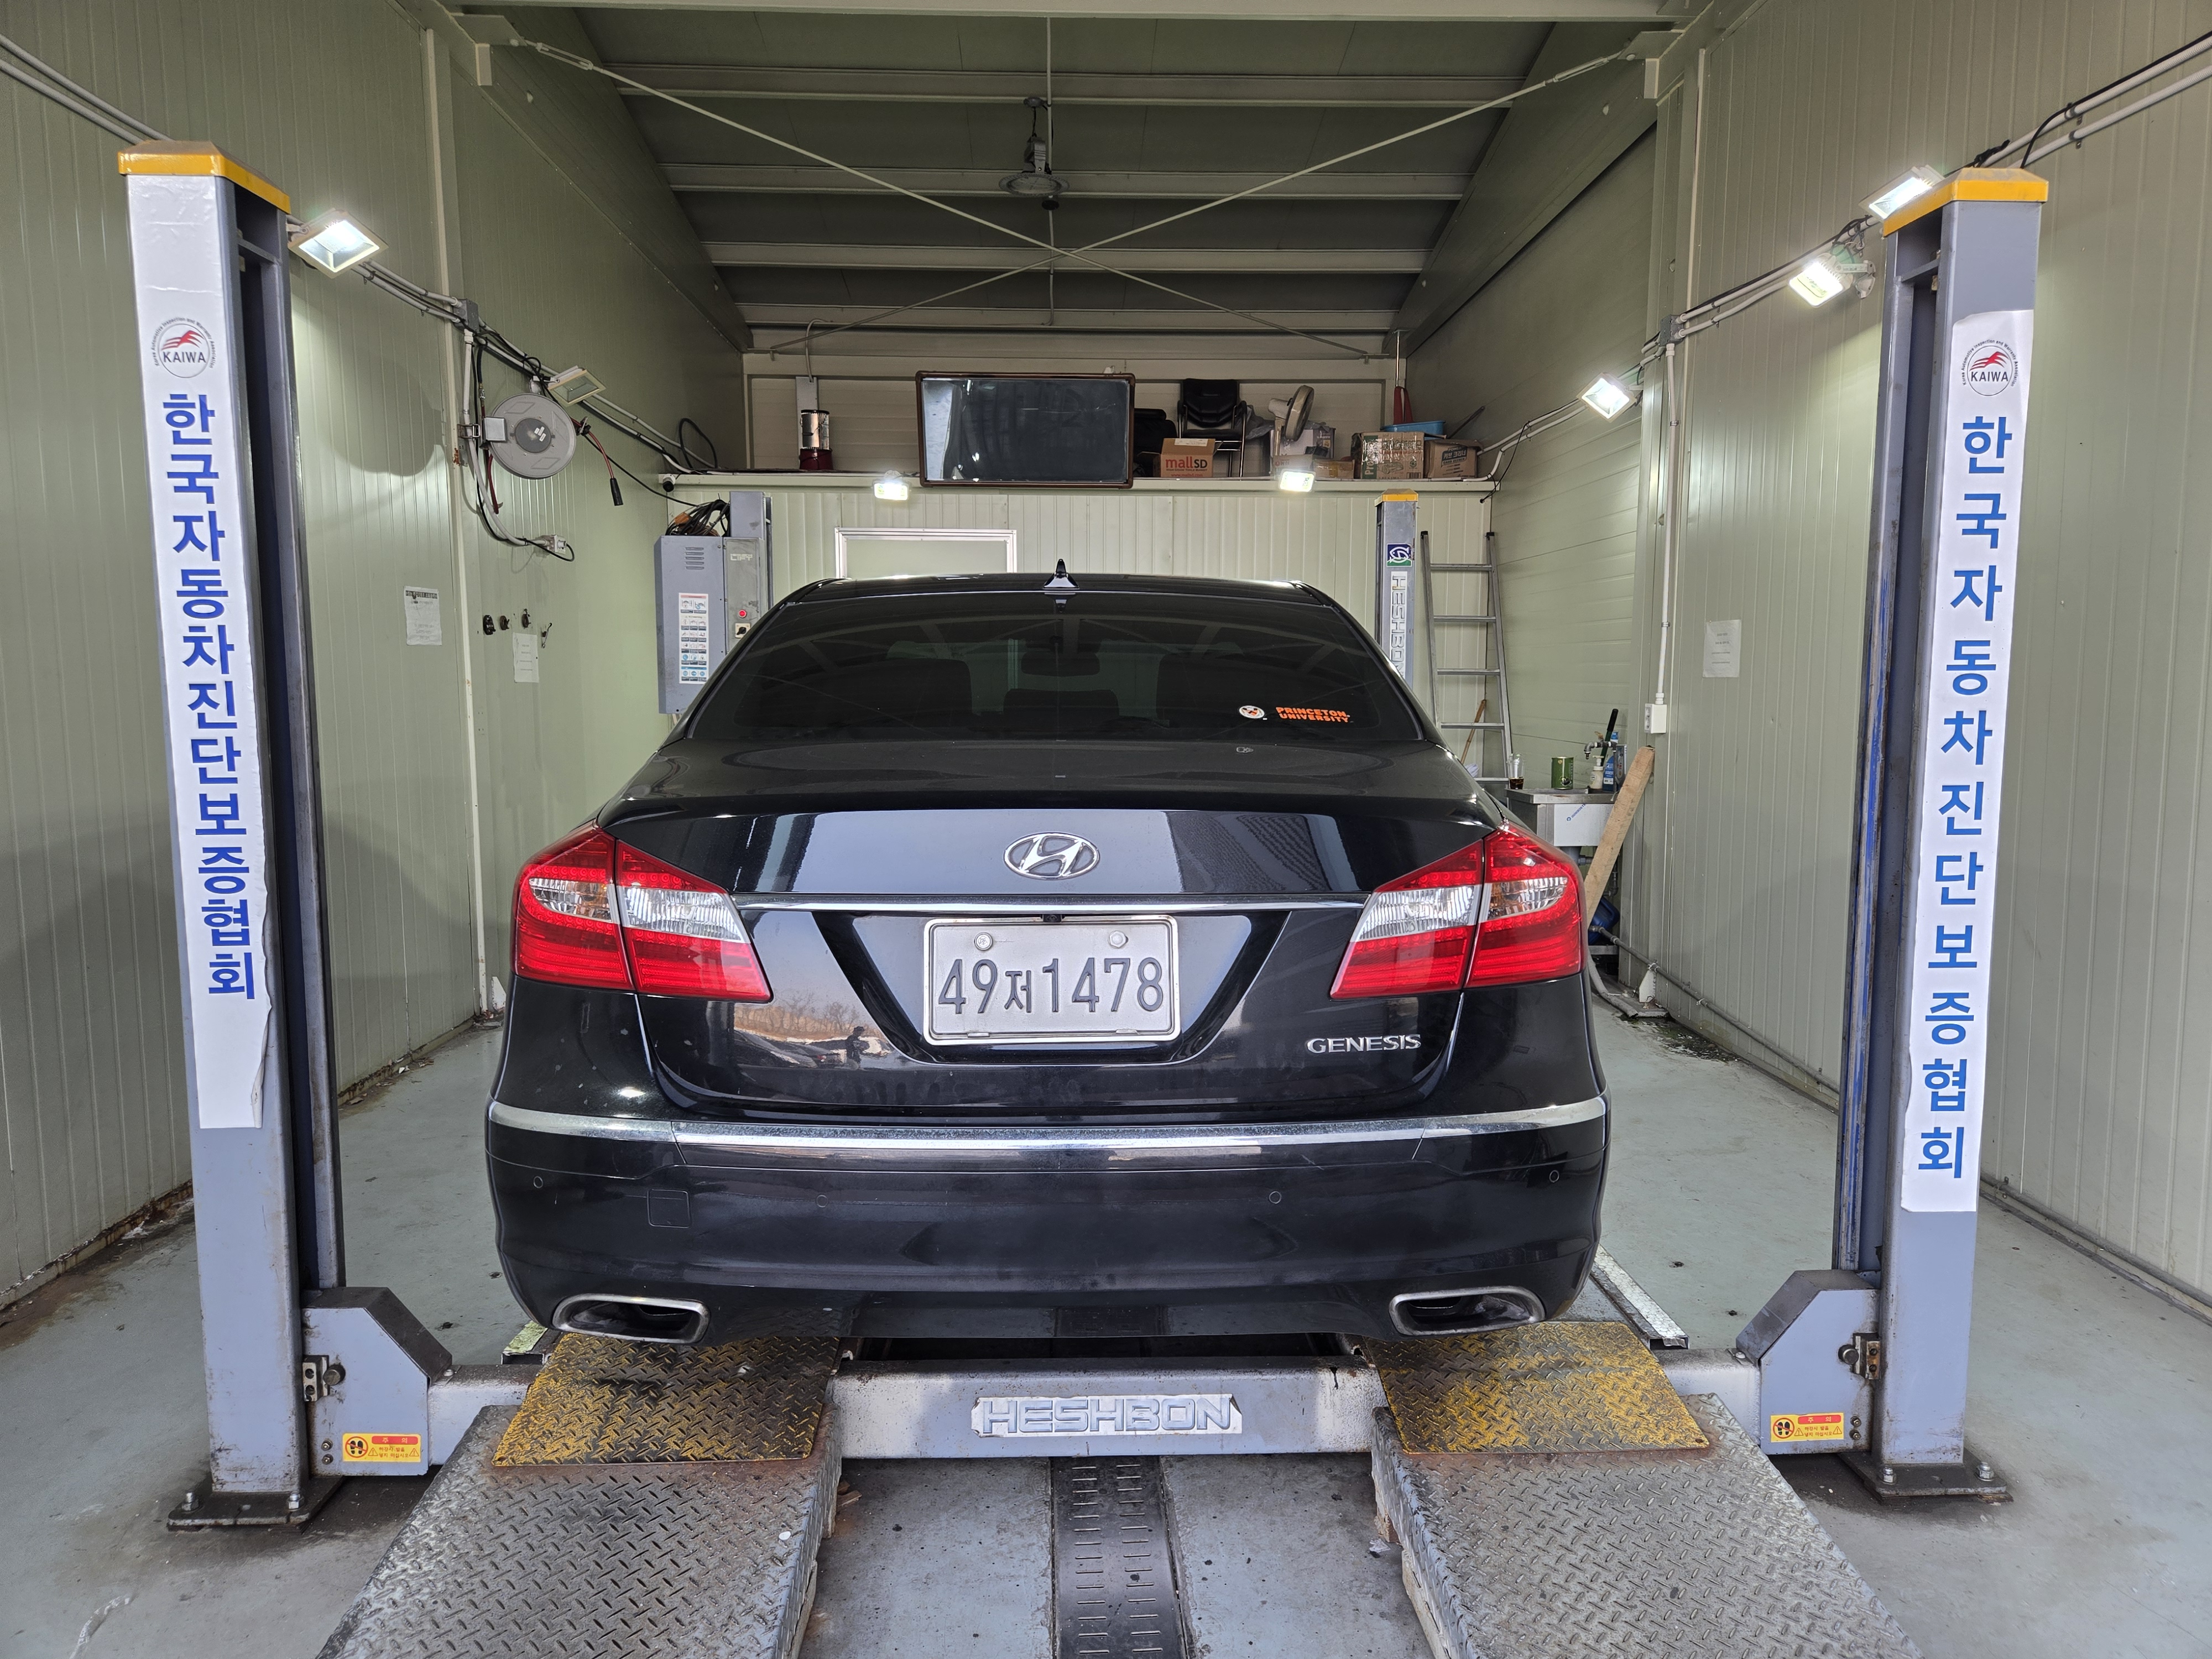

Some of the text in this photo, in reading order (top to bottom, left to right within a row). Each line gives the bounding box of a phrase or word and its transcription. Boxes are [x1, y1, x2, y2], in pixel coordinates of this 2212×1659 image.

[163, 351, 207, 363] KAIWA
[1971, 372, 2008, 382] KAIWA
[1165, 456, 1208, 468] mallSD
[163, 393, 255, 999] 한국자동차진단보증협회
[1276, 707, 1347, 717] PRINCETON
[1279, 713, 1349, 723] UNIVERSITY
[1918, 416, 2012, 1178] 한국자동차진단보증협회
[938, 957, 1164, 1014] 49저1478
[1307, 1034, 1421, 1053] GENESIS
[982, 1397, 1232, 1433] HESHBON
